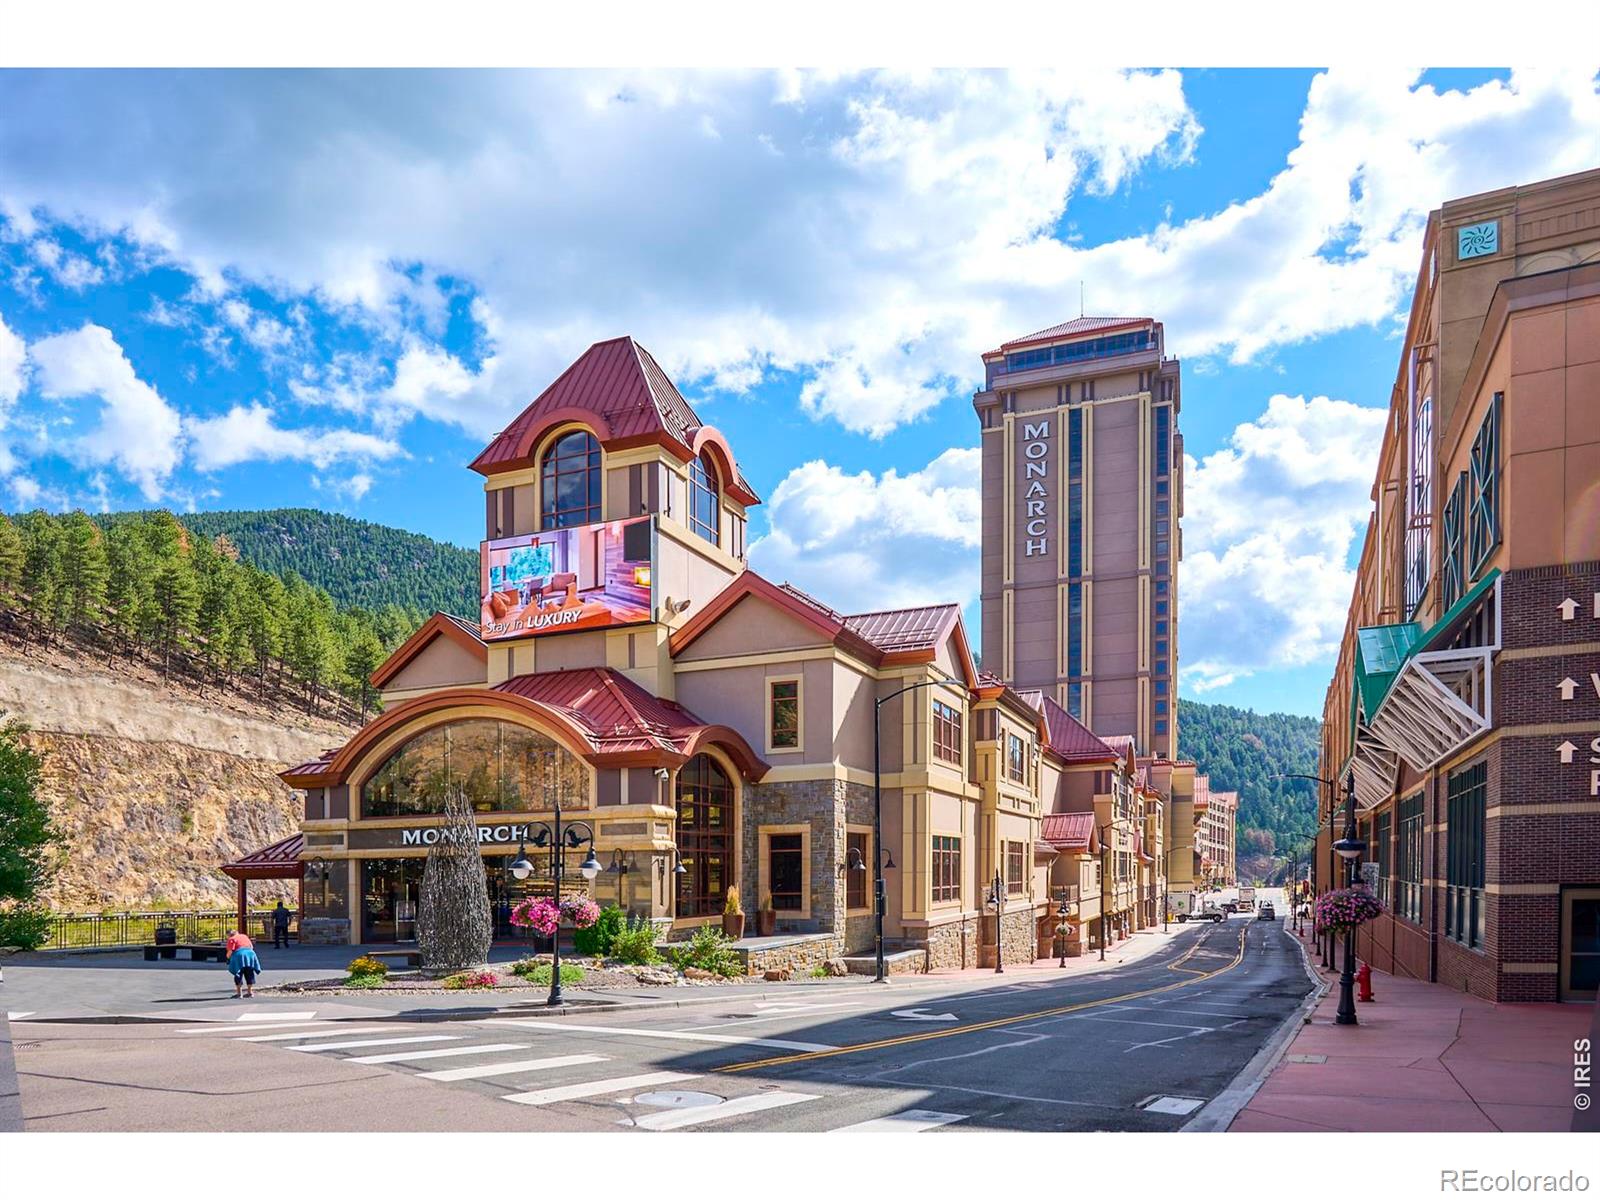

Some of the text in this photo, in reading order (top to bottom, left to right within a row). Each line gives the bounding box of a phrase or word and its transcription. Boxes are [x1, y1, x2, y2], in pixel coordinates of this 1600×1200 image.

[1023, 421, 1050, 556] MONARCH
[486, 620, 510, 634] Stay
[527, 610, 582, 629] LUXURY
